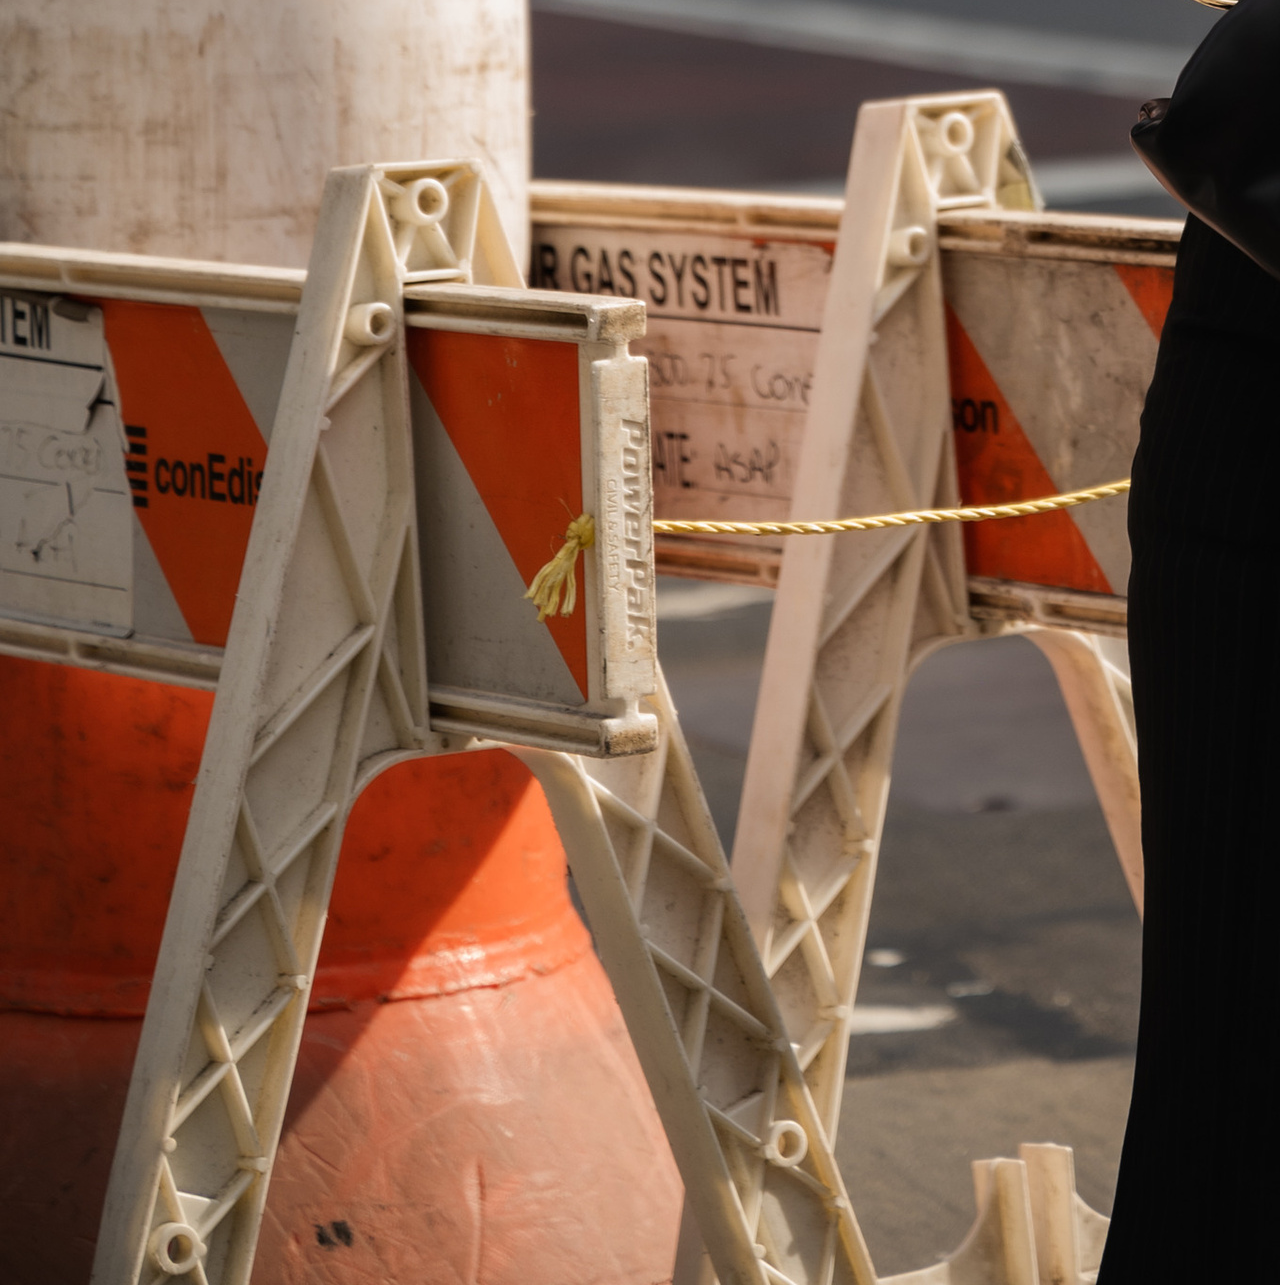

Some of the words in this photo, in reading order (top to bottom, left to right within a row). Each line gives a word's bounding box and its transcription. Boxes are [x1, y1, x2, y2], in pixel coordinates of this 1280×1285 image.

[570, 245, 638, 297] GAS
[648, 249, 781, 317] SYSTEM
[603, 477, 619, 517] CIVIL
[606, 533, 621, 592] SAFETY
